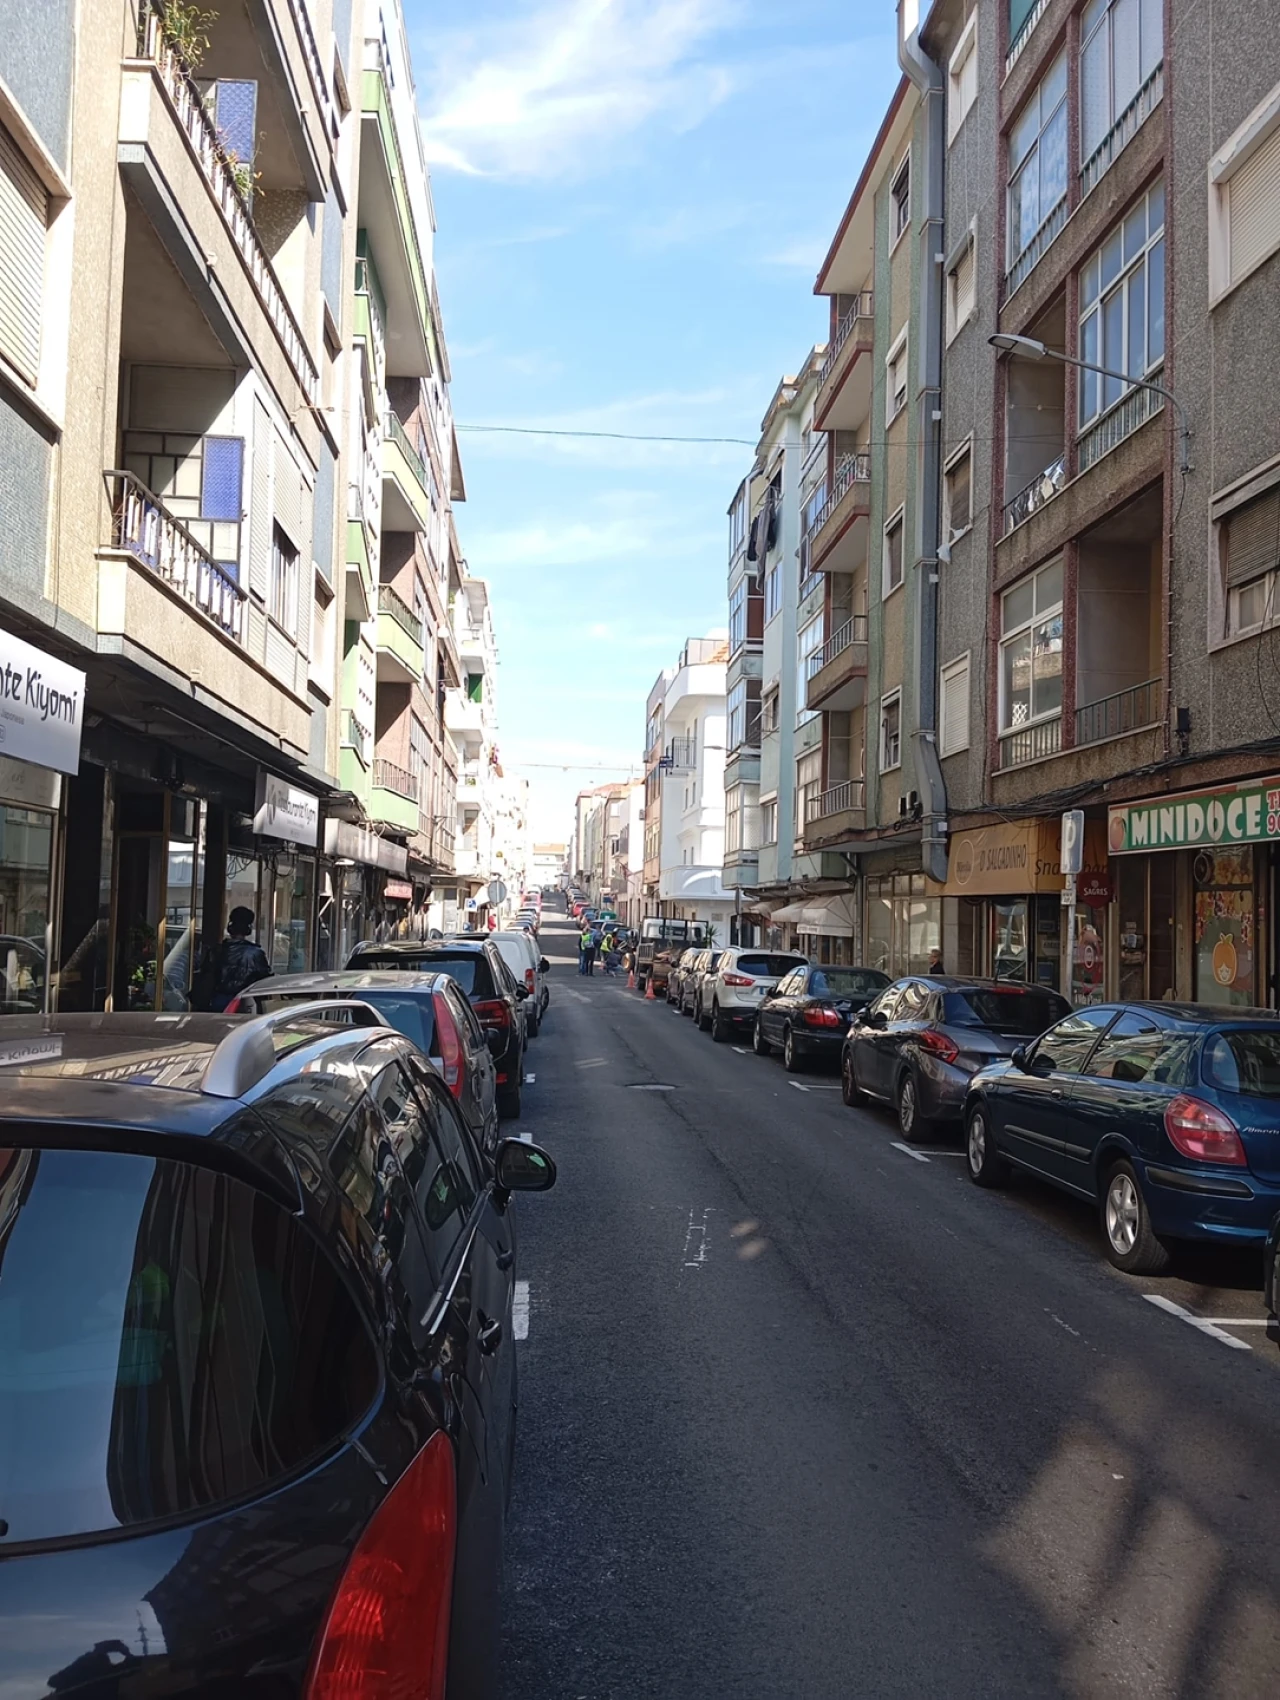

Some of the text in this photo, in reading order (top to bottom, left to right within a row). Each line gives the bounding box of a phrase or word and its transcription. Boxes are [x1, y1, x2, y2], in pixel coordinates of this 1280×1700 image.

[25, 667, 78, 725] Kiyomi
[1131, 794, 1262, 846] MINIDOCE
[1083, 887, 1109, 896] SAGRES
